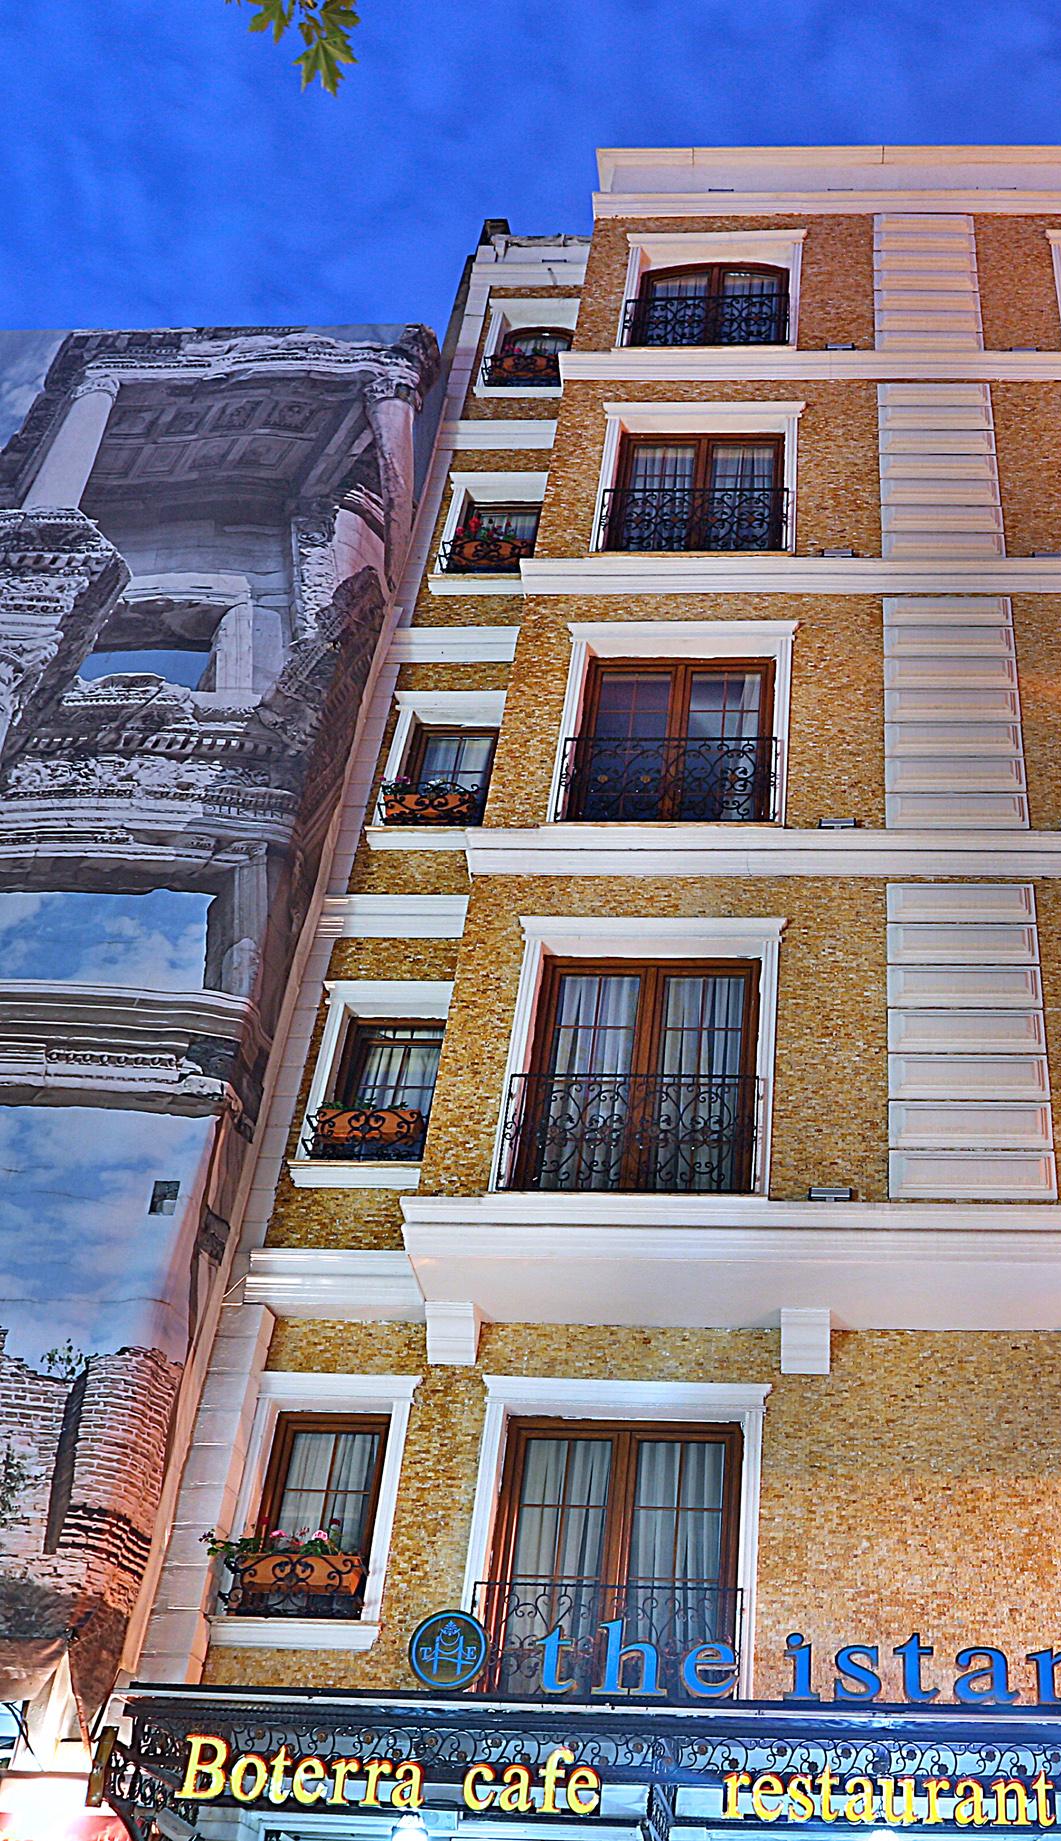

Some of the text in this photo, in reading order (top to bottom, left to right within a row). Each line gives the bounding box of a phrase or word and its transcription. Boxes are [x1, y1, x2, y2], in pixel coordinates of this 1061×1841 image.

[535, 1617, 740, 1698] the
[174, 1733, 601, 1815] Boterra cafe
[721, 1767, 1057, 1828] restaurant
